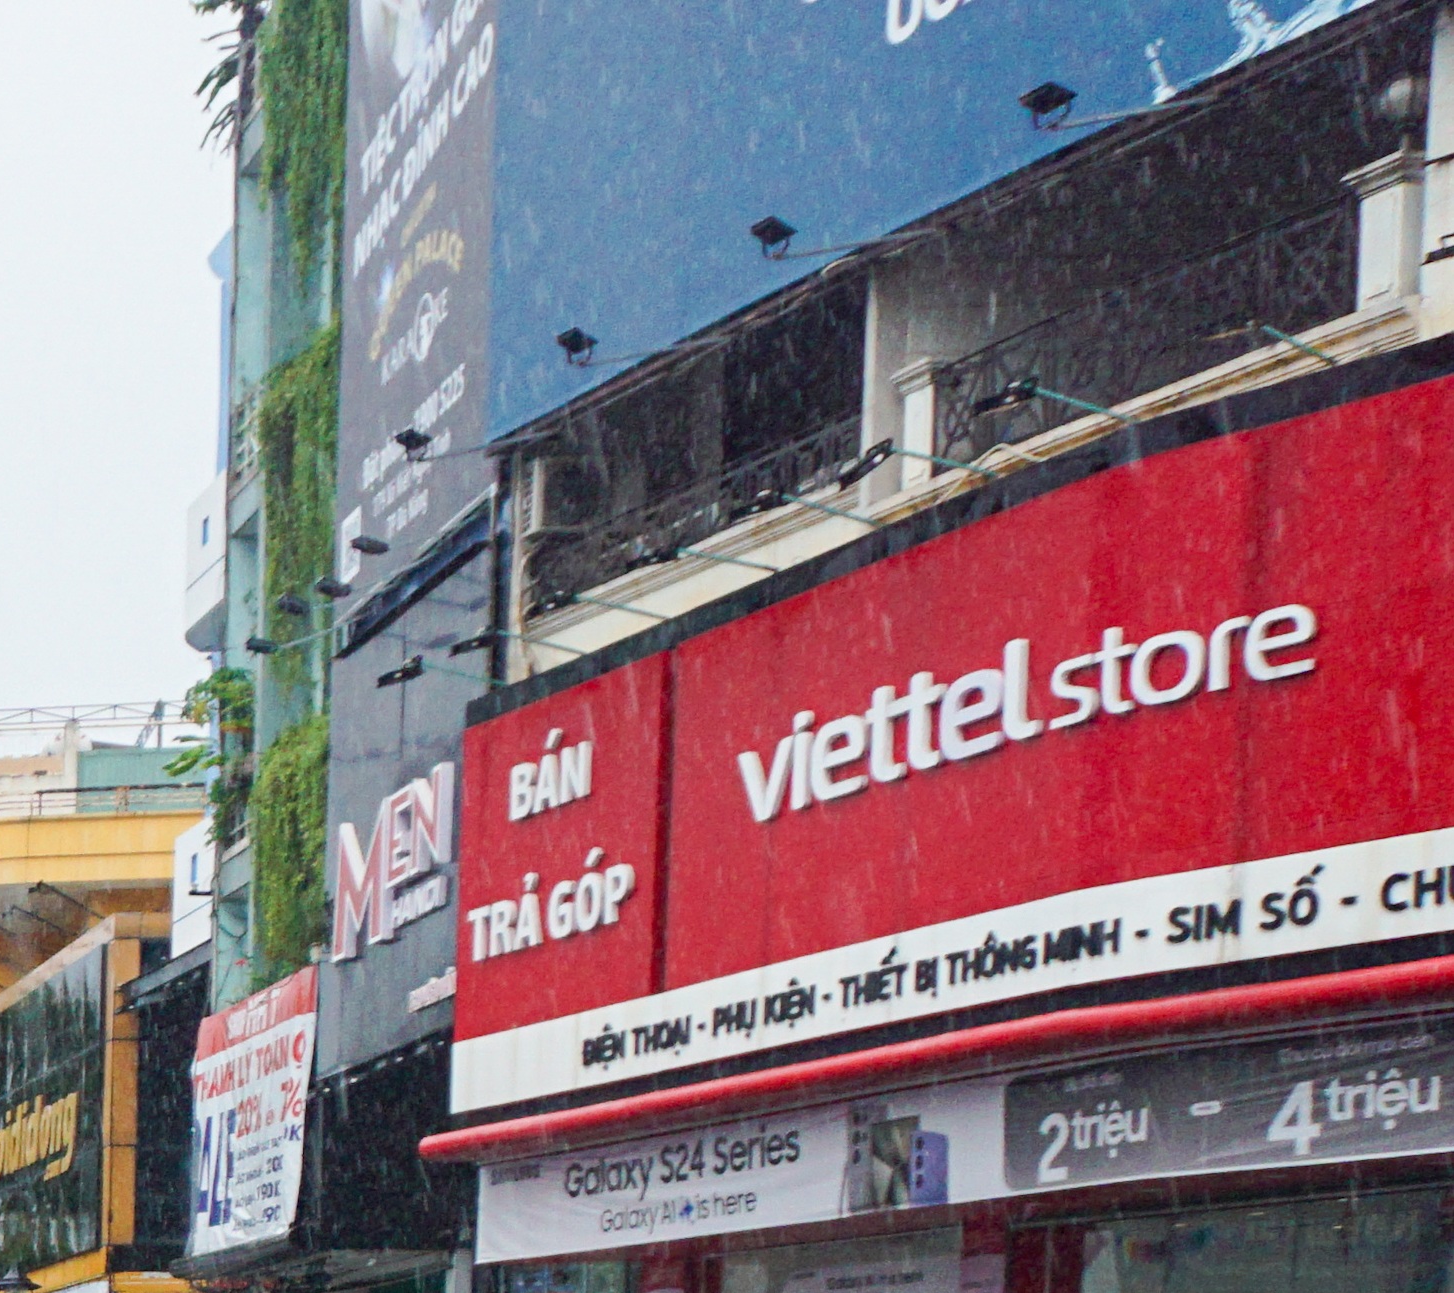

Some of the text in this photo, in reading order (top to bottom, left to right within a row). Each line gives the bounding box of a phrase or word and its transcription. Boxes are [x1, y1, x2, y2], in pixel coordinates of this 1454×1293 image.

[451, 22, 494, 118] CAO
[507, 728, 594, 821] BÁN
[330, 761, 455, 963] MEN
[466, 847, 636, 962] TRẢ GÓP
[581, 863, 1326, 1071] ĐIỆN THOẠI PHỤ KIỆN THIẾT BỊ THÔNG MINH SIM SỐ
[564, 1123, 801, 1200] Galaxy S24 Series
[1038, 1067, 1442, 1184] 2 triệu 4 triệu
[601, 1190, 757, 1235] Galaxy AI is here
